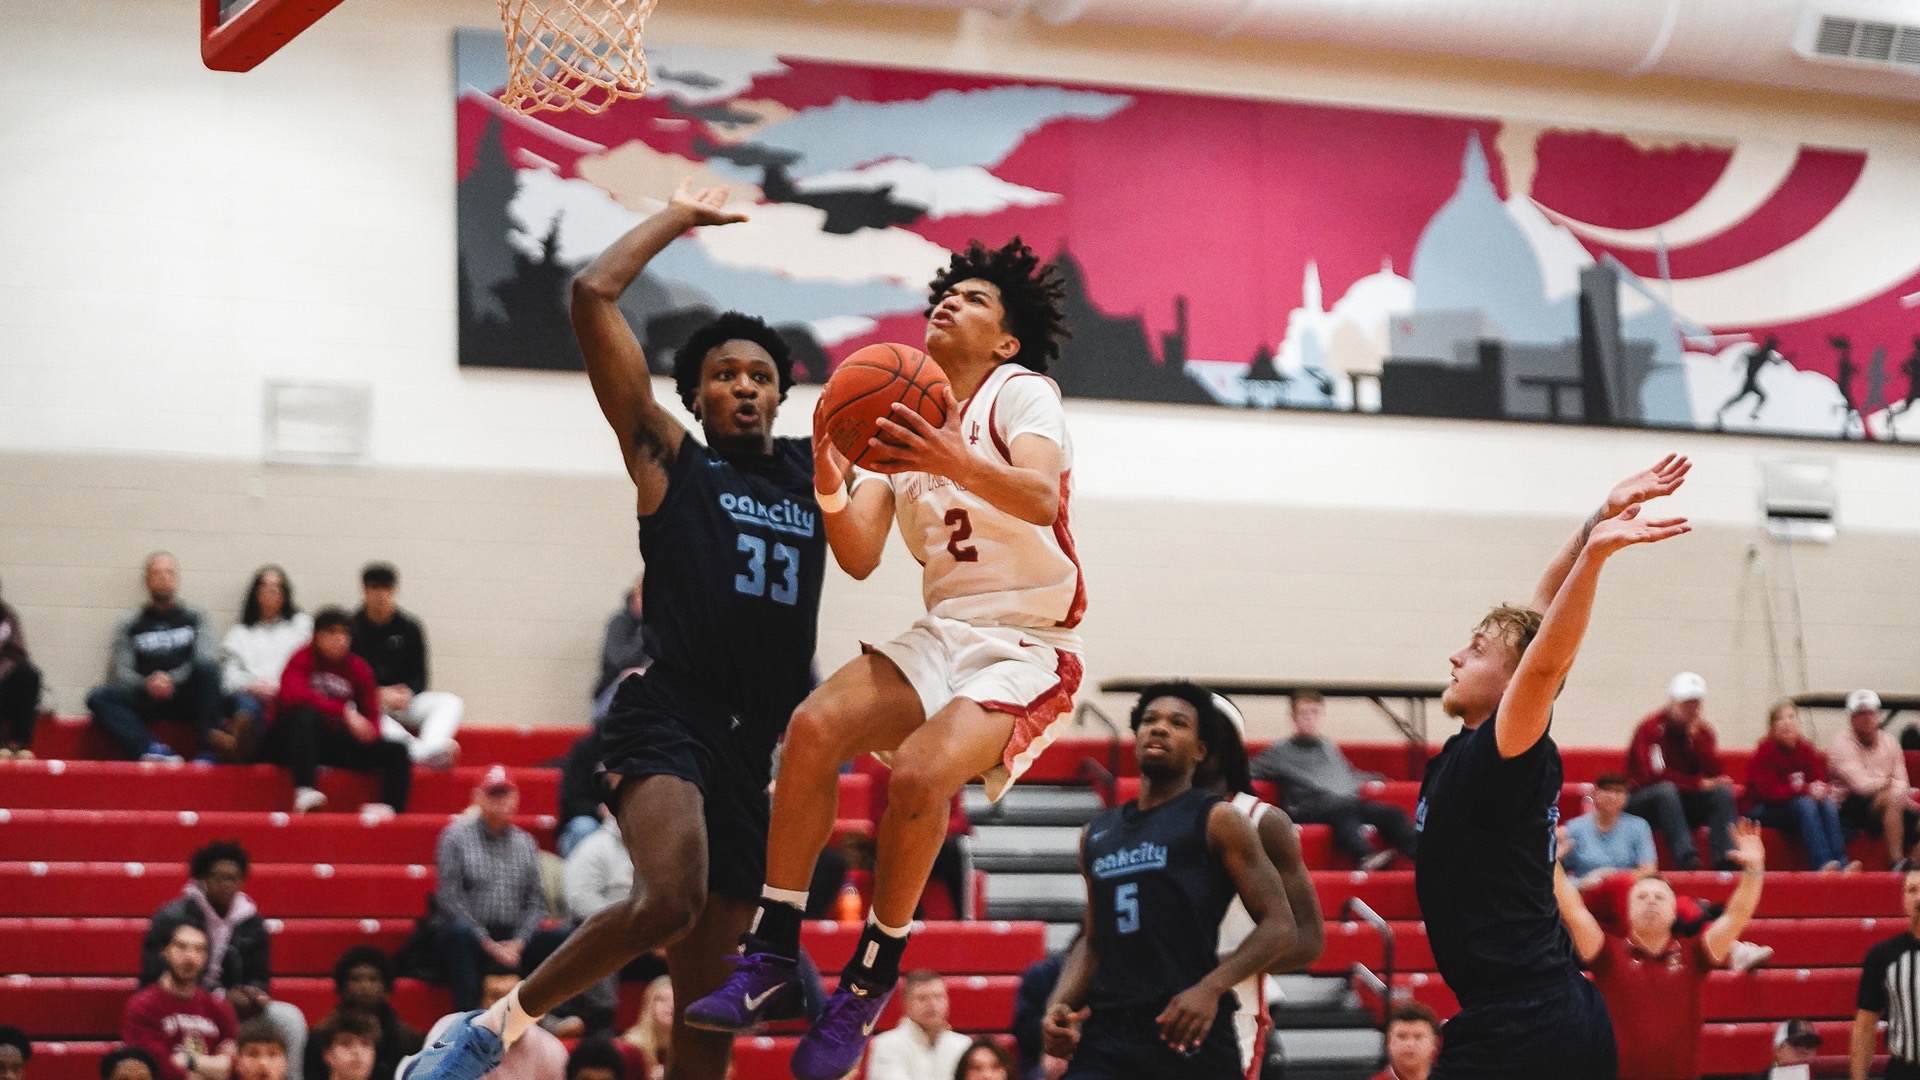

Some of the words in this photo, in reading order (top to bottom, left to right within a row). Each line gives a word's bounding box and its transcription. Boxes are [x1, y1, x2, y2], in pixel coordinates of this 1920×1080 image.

[944, 508, 979, 562] 2
[735, 533, 800, 606] 33
[1115, 882, 1140, 933] 5
